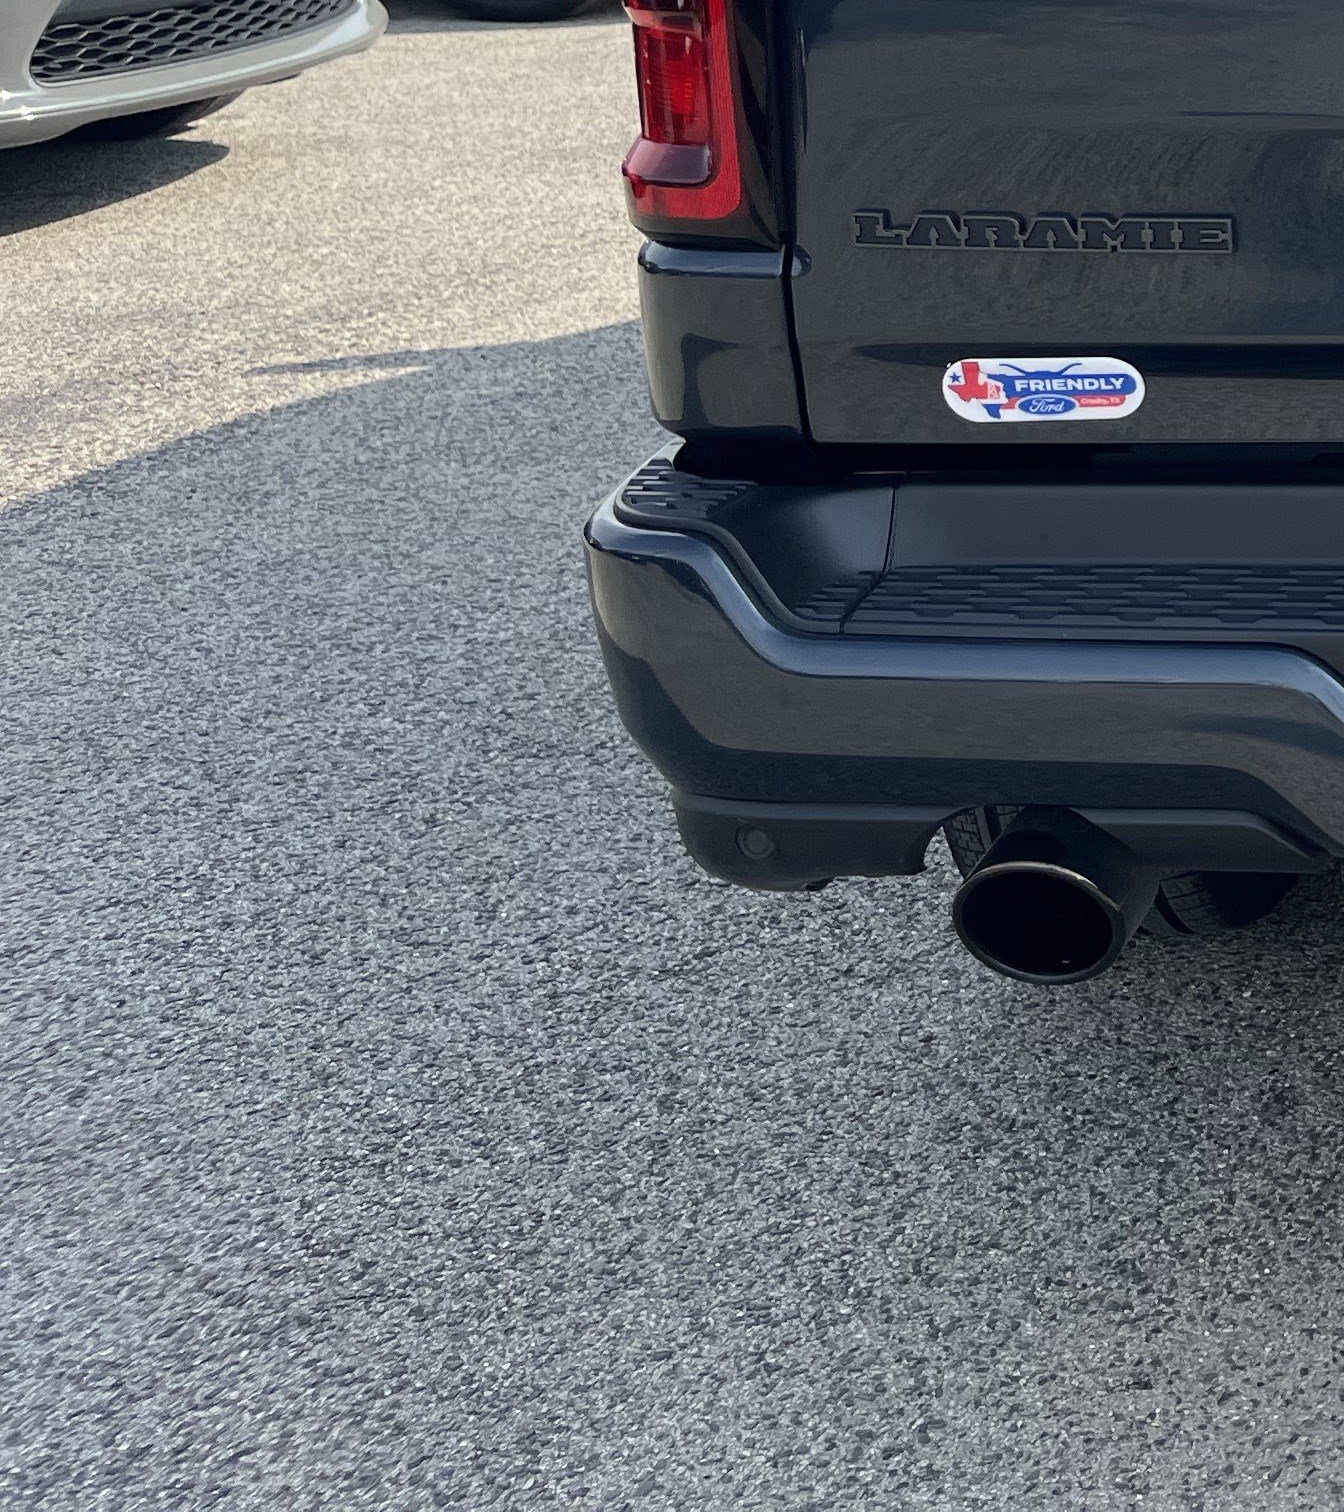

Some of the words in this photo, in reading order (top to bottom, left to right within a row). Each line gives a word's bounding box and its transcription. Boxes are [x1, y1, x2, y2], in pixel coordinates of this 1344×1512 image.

[852, 208, 1236, 255] LARAMIE
[1014, 377, 1125, 392] FRIENDLY
[1028, 397, 1065, 413] Ford
